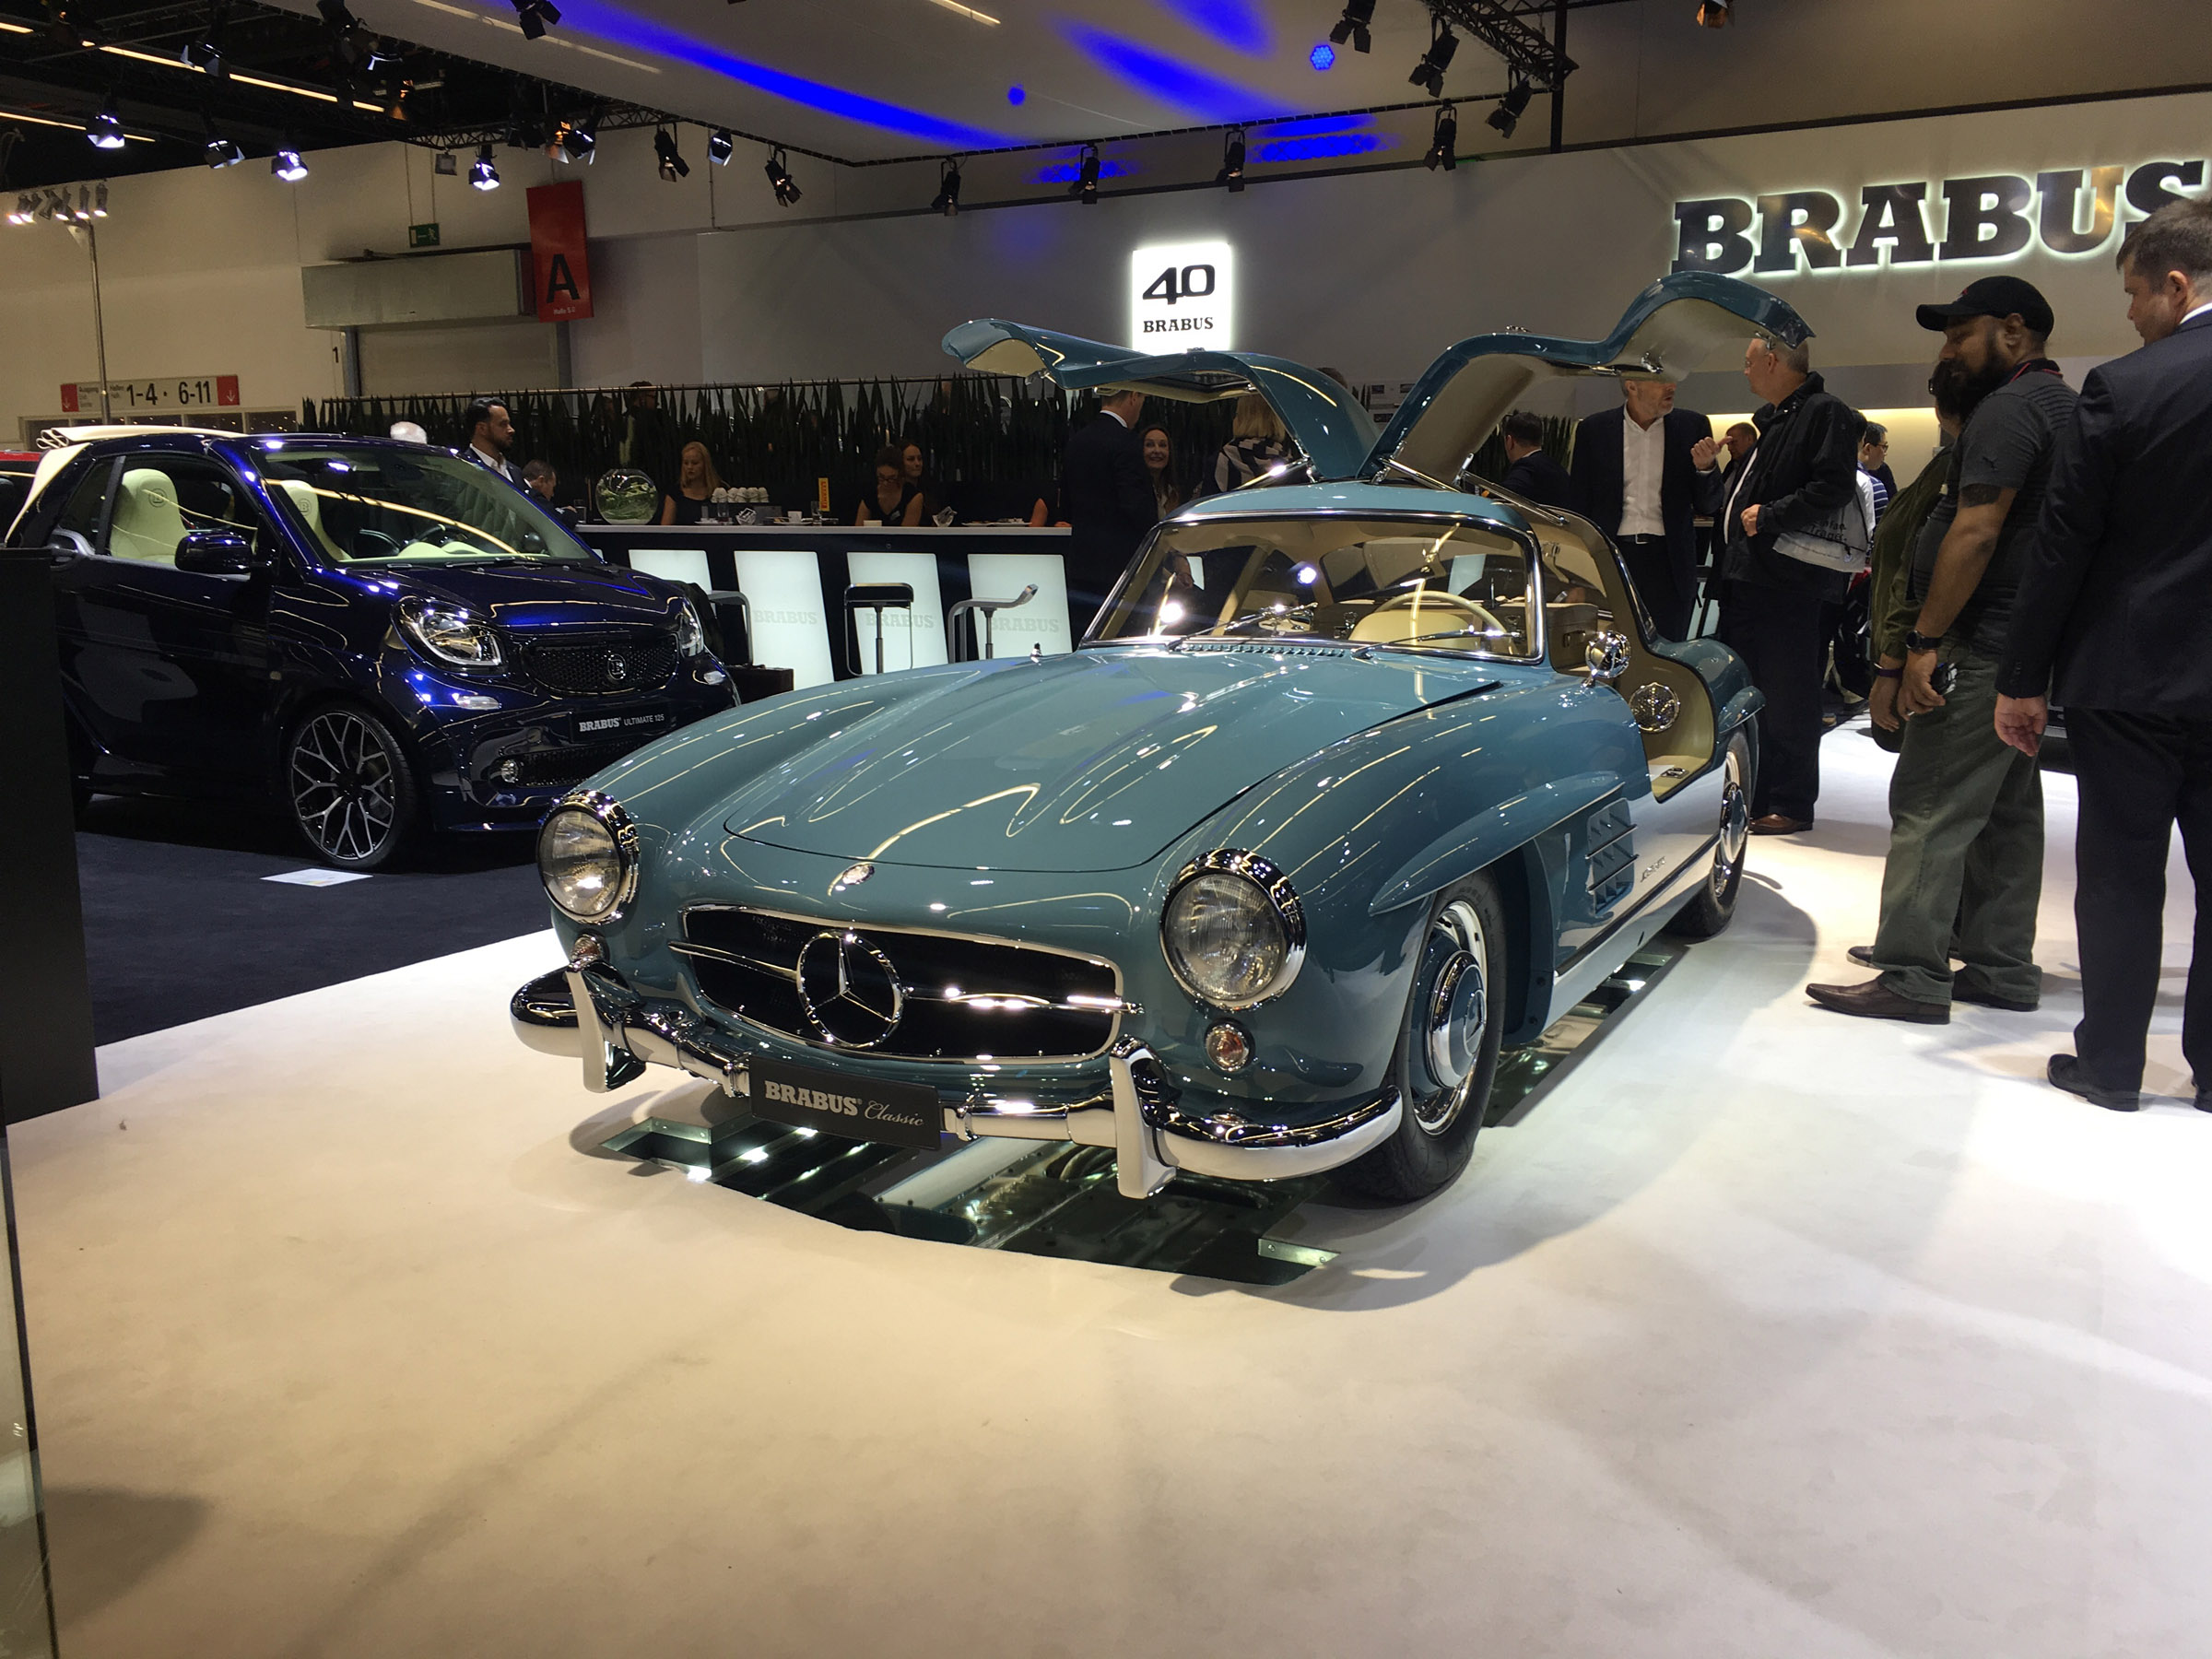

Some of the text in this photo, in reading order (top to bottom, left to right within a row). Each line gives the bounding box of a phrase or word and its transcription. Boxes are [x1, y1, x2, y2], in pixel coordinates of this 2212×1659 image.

[1671, 159, 2205, 275] BRABUS
[546, 253, 581, 303] A
[1142, 265, 1216, 305] 40
[1143, 316, 1214, 333] BRABUS
[332, 346, 339, 363] 1
[126, 383, 158, 406] 1-4
[178, 381, 211, 406] 6-11
[754, 610, 818, 626] BRABUS
[865, 612, 935, 629] BRABUS
[989, 617, 1060, 633] BRABUS
[623, 714, 653, 726] ULTIMATE
[654, 713, 665, 722] 125
[865, 1100, 925, 1127] Classic
